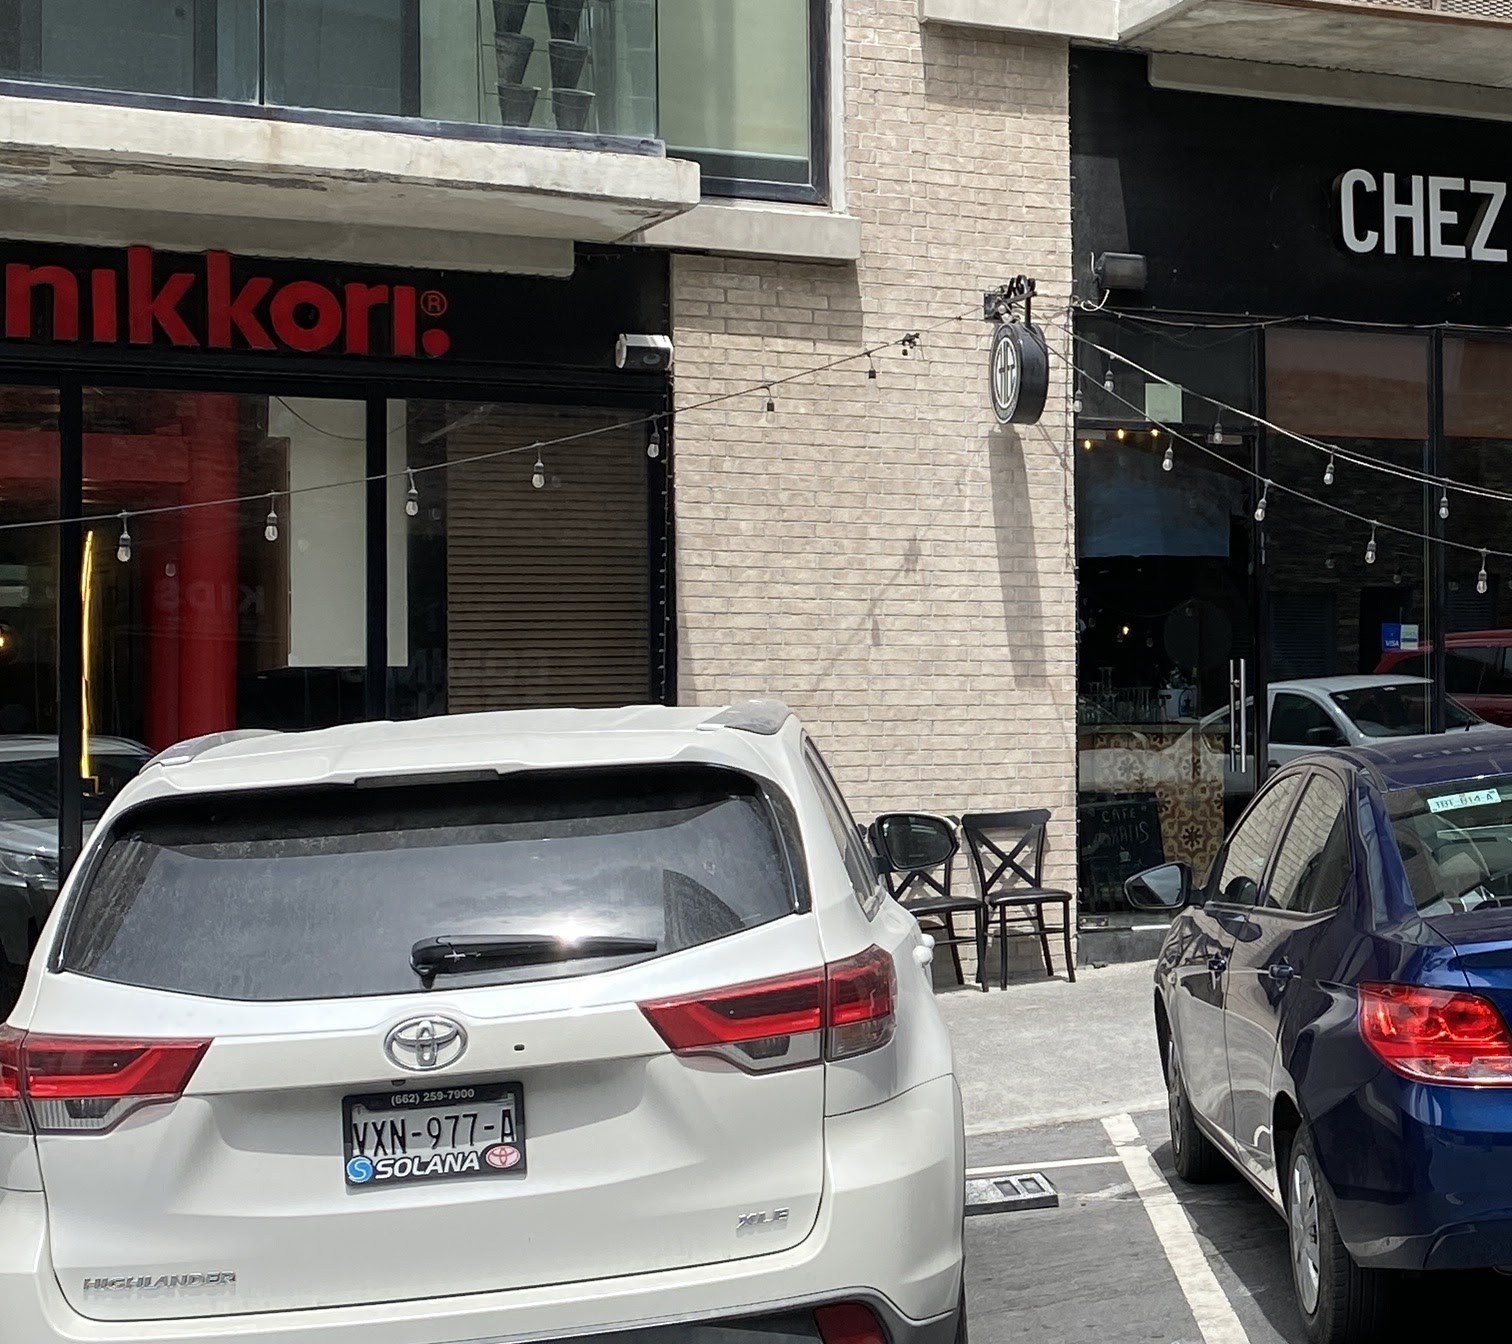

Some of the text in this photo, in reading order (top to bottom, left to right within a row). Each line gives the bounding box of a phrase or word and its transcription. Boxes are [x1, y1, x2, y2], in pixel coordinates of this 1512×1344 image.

[1338, 168, 1508, 263] CHEZ
[391, 1088, 475, 1106] (662) 259-7900
[353, 1108, 515, 1156] VXN-977-A
[375, 1151, 480, 1179] SOLANA
[736, 1207, 790, 1229] XLE
[83, 1271, 236, 1290] HIGHLANDER
